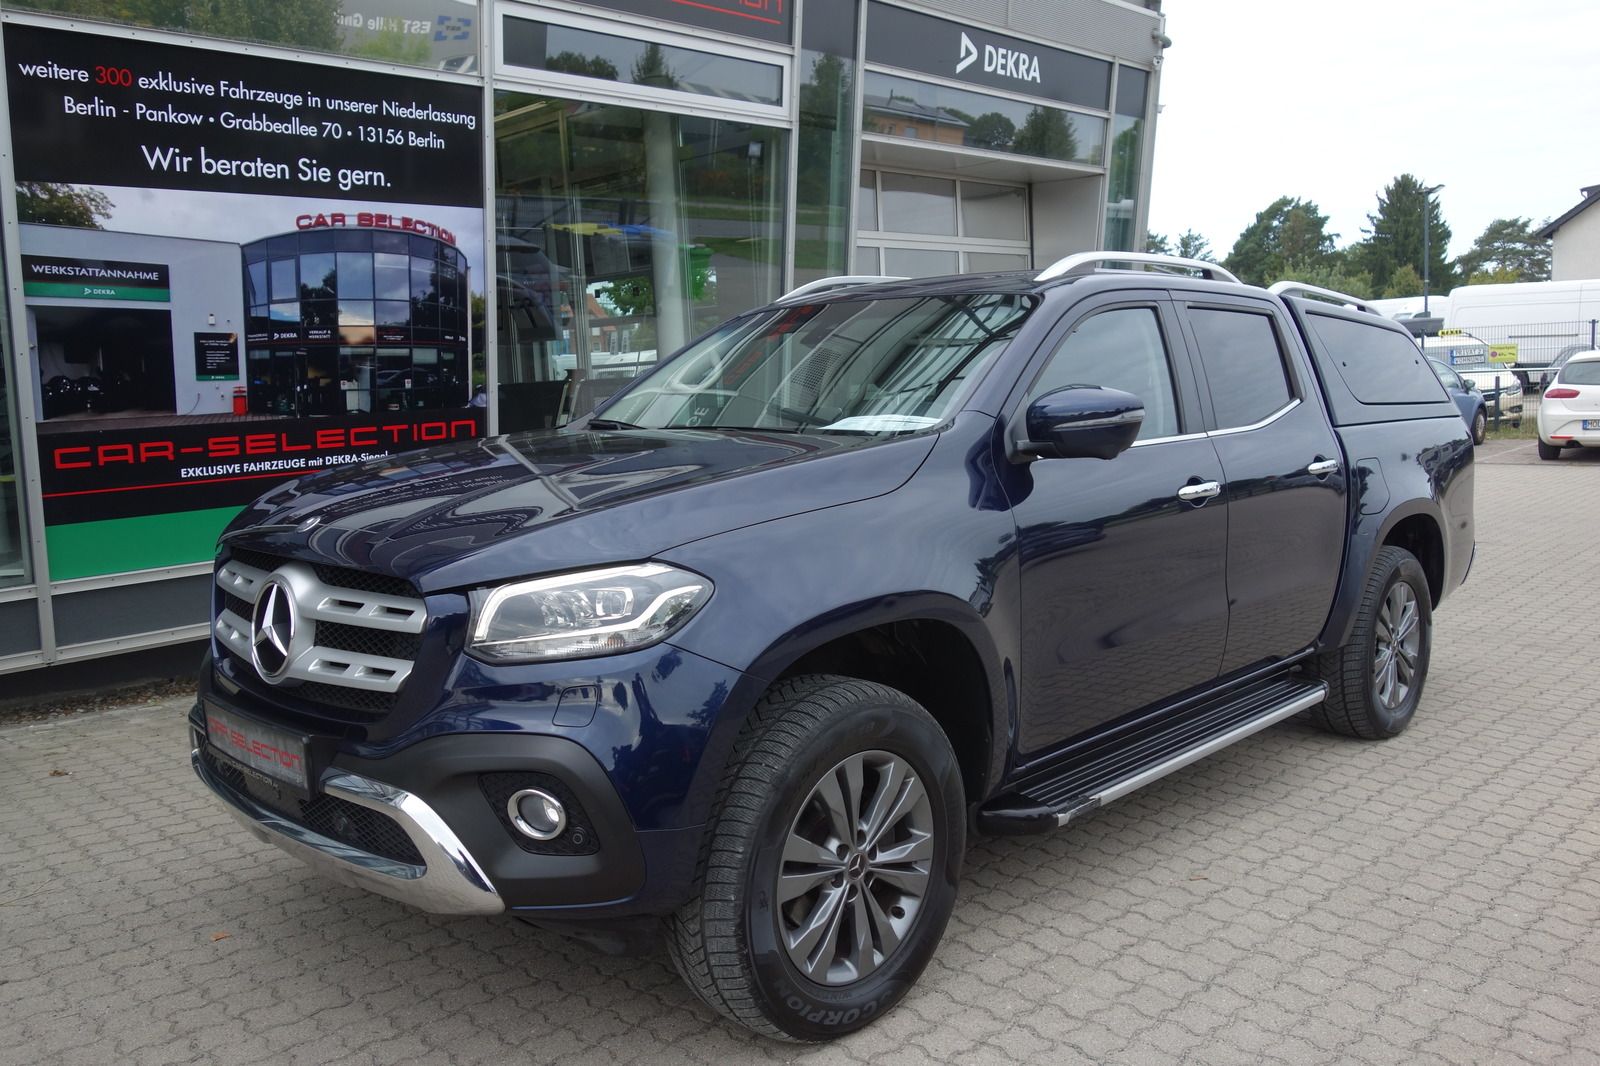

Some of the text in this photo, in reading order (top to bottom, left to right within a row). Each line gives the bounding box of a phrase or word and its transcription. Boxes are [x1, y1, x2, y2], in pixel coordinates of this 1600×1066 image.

[984, 44, 1041, 83] DEKRA
[18, 61, 476, 130] weitere 300 exklusive Fahrzeuge in unserer Niederlassung
[64, 96, 117, 118] Berlin
[136, 103, 203, 125] Pankow
[220, 112, 318, 136] Grabbeallee
[321, 122, 342, 139] 70
[358, 126, 404, 145] 13156
[408, 131, 445, 149] Berlin
[141, 145, 392, 191] Wir beraten Sie gern.
[296, 212, 456, 246] CAR SELECTION
[31, 264, 160, 281] WERKSTATTANNAHME
[54, 420, 477, 469] CAR-SELECTION
[181, 462, 241, 478] EXKLUSIVE
[243, 458, 306, 474] FAHRZEUGE
[308, 456, 323, 468] mit
